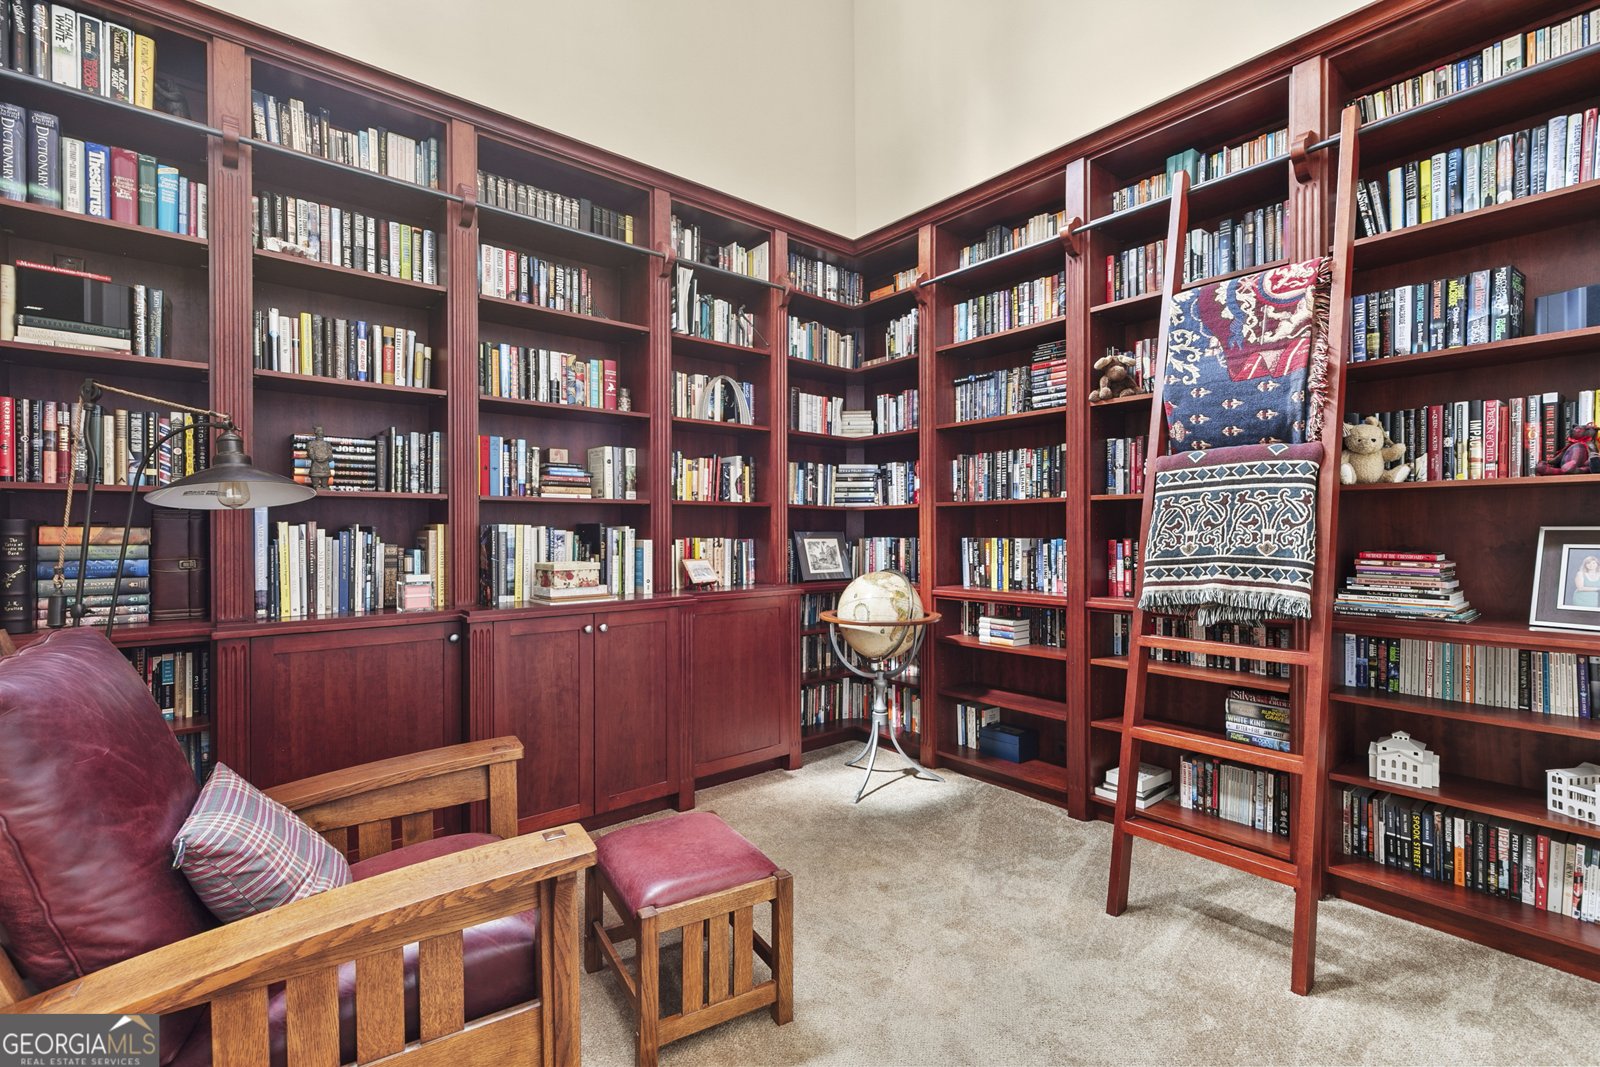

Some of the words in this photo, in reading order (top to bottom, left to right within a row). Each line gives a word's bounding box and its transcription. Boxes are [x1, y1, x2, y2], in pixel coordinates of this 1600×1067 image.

[55, 14, 66, 43] WHITE
[64, 13, 74, 42] LETHAL
[84, 21, 92, 54] GALBRAITH
[83, 59, 92, 88] BLOOD
[111, 67, 120, 90] HEART
[1573, 123, 1582, 146] SECOND
[1, 116, 15, 182] DICTIONARY
[35, 124, 50, 189] DICTIONARY
[1573, 146, 1581, 158] LIFE
[1432, 157, 1441, 171] RED
[1448, 151, 1457, 172] BLACK
[1572, 163, 1580, 177] NICK
[88, 150, 106, 216] Thesaurus
[1405, 170, 1417, 199] TRICKSTER
[1432, 171, 1441, 194] QUEEN
[1448, 171, 1457, 186] WOLF
[1481, 159, 1490, 193] COUNTRY
[555, 266, 564, 295] AUTOPSY
[1433, 281, 1442, 298] STUART
[1398, 288, 1407, 304] STUART
[1416, 284, 1425, 301] STUART
[1448, 279, 1459, 308] MACBRIDE
[1353, 302, 1365, 327] DYING
[1368, 298, 1378, 329] BLOODSHOT
[1398, 303, 1406, 326] MACBRIDE
[1416, 300, 1424, 323] MACBRIDE
[1433, 297, 1442, 320] MACBRIDE
[1452, 306, 1460, 321] Close
[1353, 327, 1365, 349] LIGHT
[1416, 322, 1424, 332] Dark
[1470, 325, 1481, 344] DEAD
[3, 400, 12, 438] ROBERT
[1431, 413, 1439, 429] QUEEN
[1486, 406, 1496, 434] PRESTON
[1546, 405, 1555, 419] FINAL
[1469, 419, 1482, 451] IMPACT
[1546, 420, 1555, 435] GIRLS
[335, 445, 356, 453] JOE
[356, 446, 373, 454] IDE
[1431, 435, 1439, 451] SOUTH
[1485, 439, 1496, 462] CHILD
[1529, 439, 1537, 469] EXTINCTION
[1546, 438, 1555, 453] RILEY
[1232, 689, 1257, 702] Silva
[1226, 714, 1249, 724] WHITE
[1249, 718, 1266, 728] KING
[1412, 814, 1421, 840] SPOOK
[1498, 829, 1510, 861] DEPTHS
[1511, 834, 1519, 851] PETER
[1412, 841, 1421, 868] STREET
[1511, 851, 1519, 864] MAY
